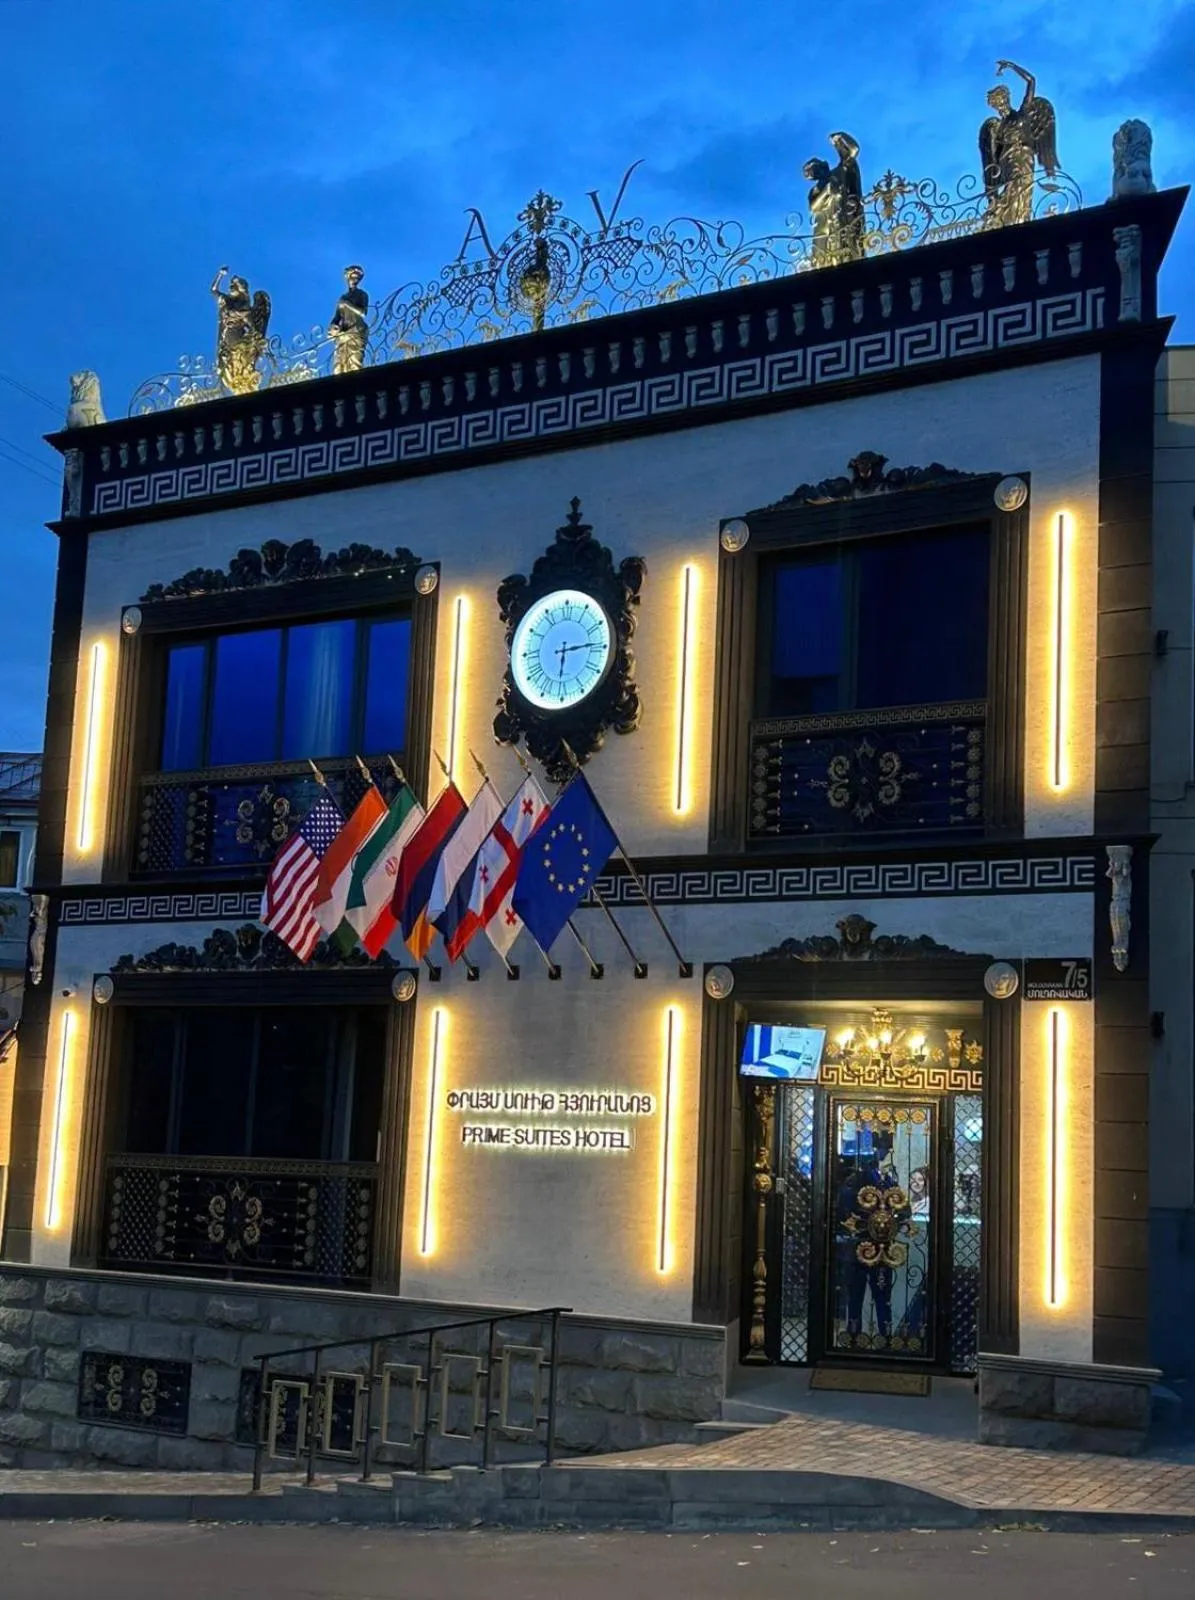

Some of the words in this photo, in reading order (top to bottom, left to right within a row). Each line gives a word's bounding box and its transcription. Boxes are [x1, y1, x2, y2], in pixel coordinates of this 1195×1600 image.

[1061, 961, 1088, 988] 7/5
[447, 1091, 501, 1110] ՓՐԱՅՄ
[504, 1092, 555, 1110] ՍՈՒԻԹ
[559, 1093, 651, 1113] ՀՅՈՒՐԱՆՈՑ
[462, 1126, 511, 1144] PRIME
[514, 1128, 572, 1146] SUITES
[575, 1130, 630, 1149] HOTEL
